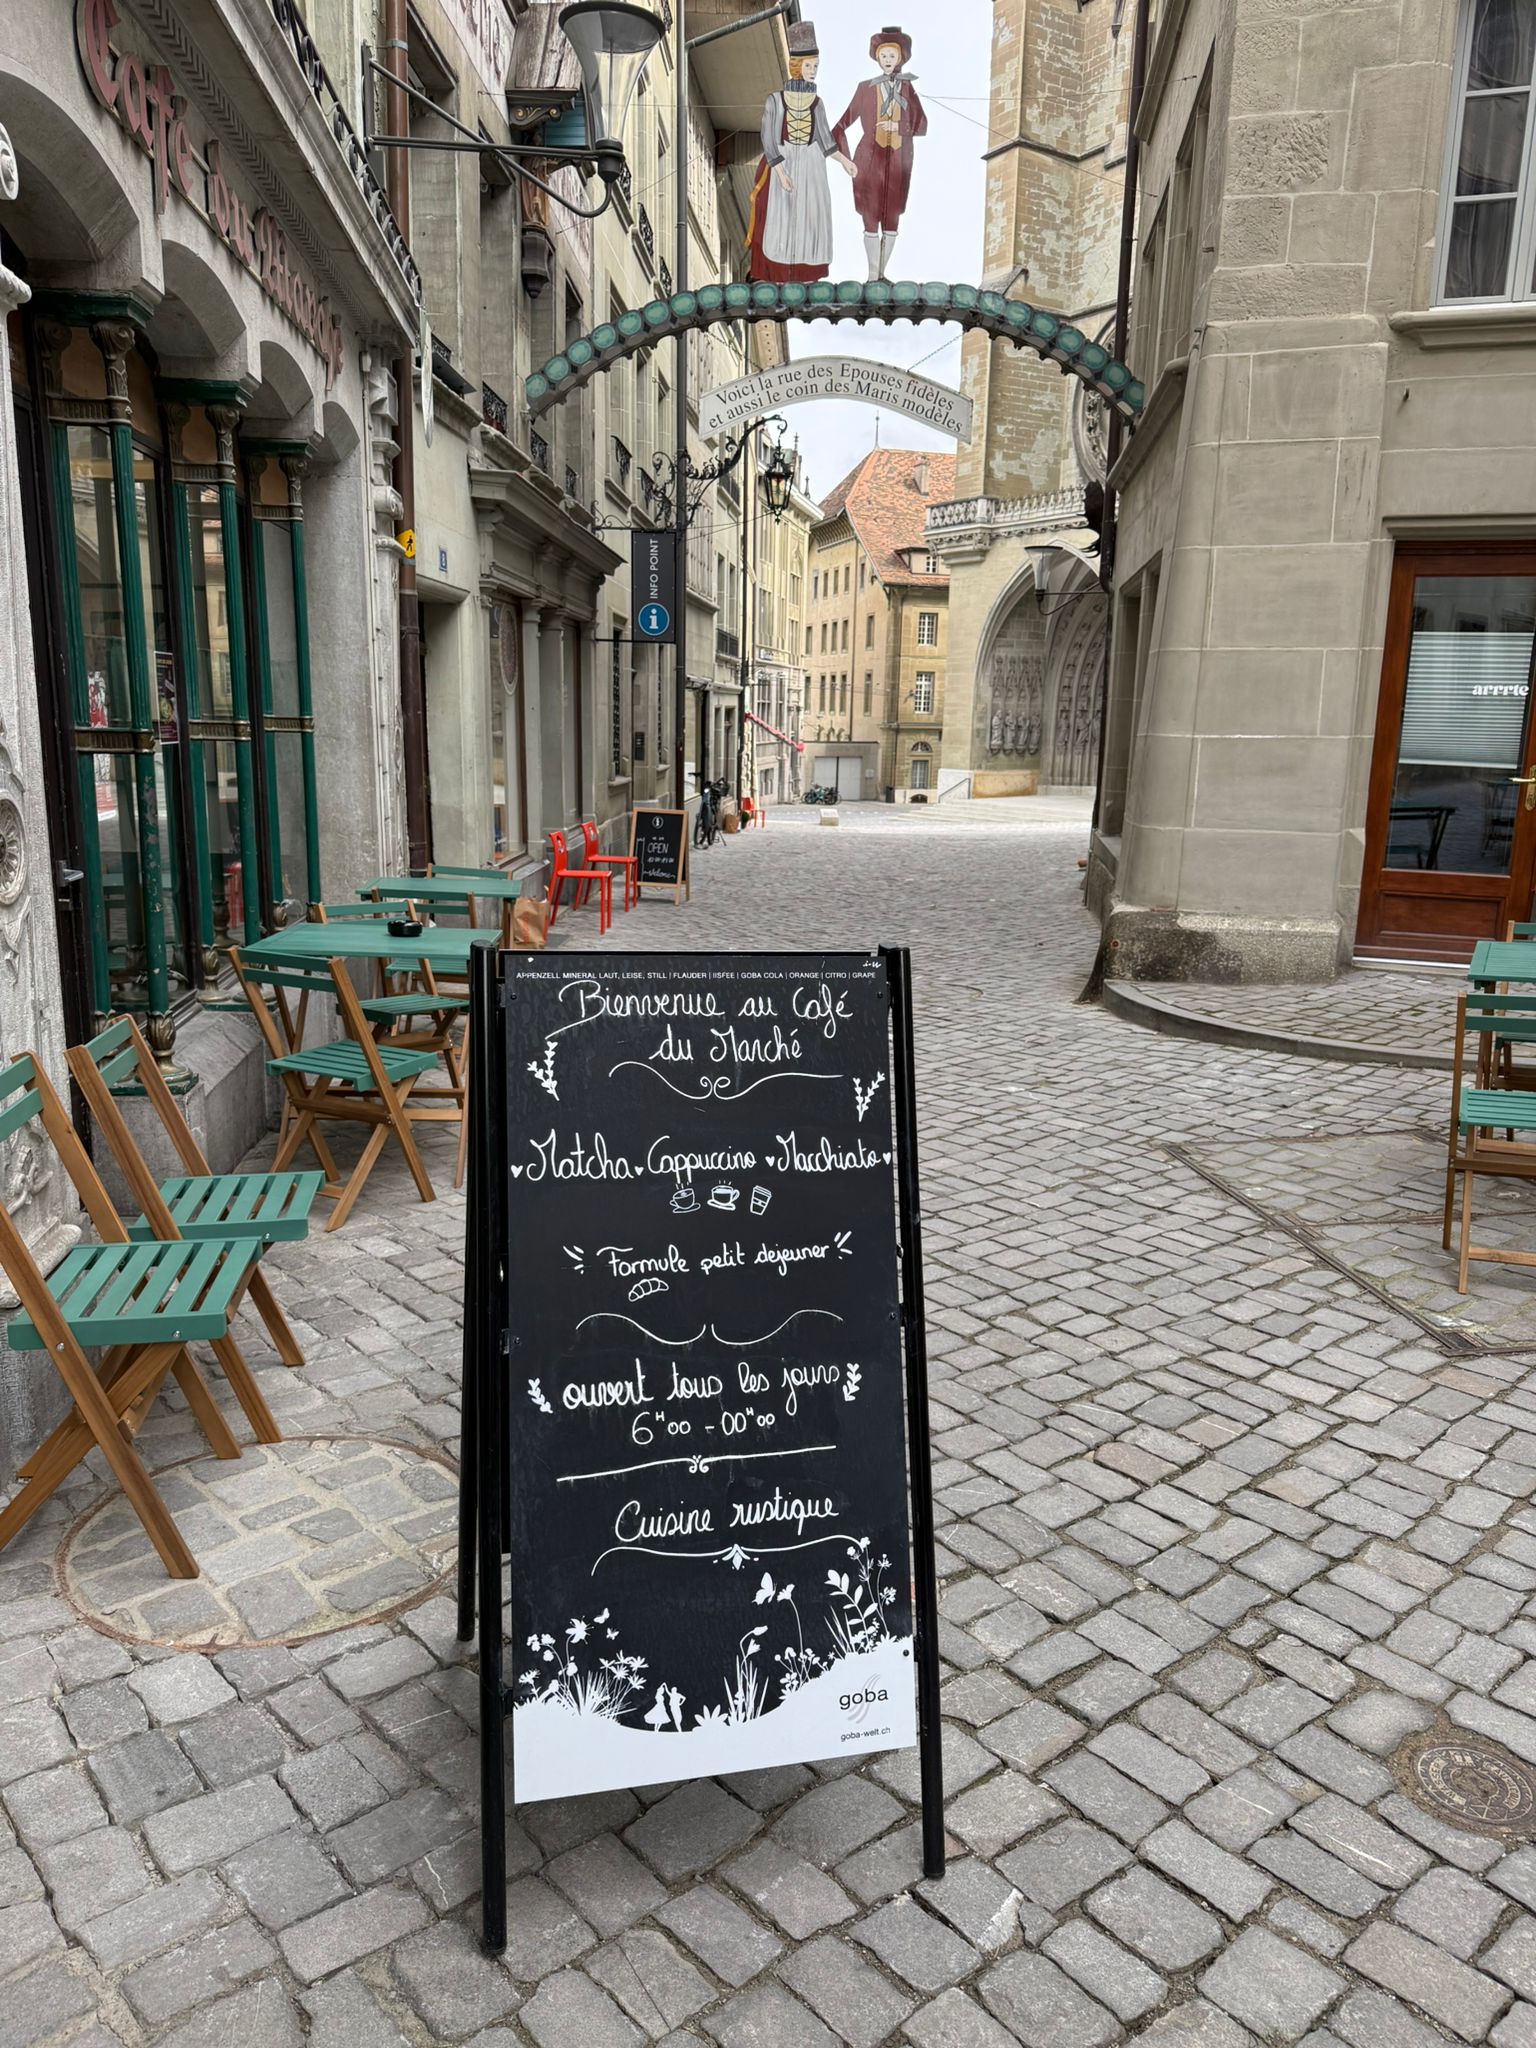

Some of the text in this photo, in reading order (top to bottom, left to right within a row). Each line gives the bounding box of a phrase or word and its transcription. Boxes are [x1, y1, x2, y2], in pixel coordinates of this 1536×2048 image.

[74, 0, 194, 215] Café
[206, 139, 252, 270] du
[709, 379, 963, 433] et aussi le coin des Maris modèles
[716, 362, 955, 411] Voici la rue des Epouses fidèles
[649, 538, 659, 599] INFO POINT
[1472, 684, 1530, 696] arrrte
[647, 842, 669, 854] OPEN
[599, 972, 620, 980] LAUT,
[622, 972, 645, 980] LEISE,
[547, 980, 853, 1038] Bienvenue au Café
[649, 1023, 802, 1062] du Marché
[526, 1129, 881, 1184] Matcha Cappuccino Macchiato
[597, 1242, 829, 1276] Formule petit dejeuner
[562, 1357, 840, 1416] ouvert tous les jours
[615, 1486, 839, 1542] Cuisine rustique
[839, 1688, 889, 1710] goba
[840, 1726, 891, 1742] goba-welt.ch
